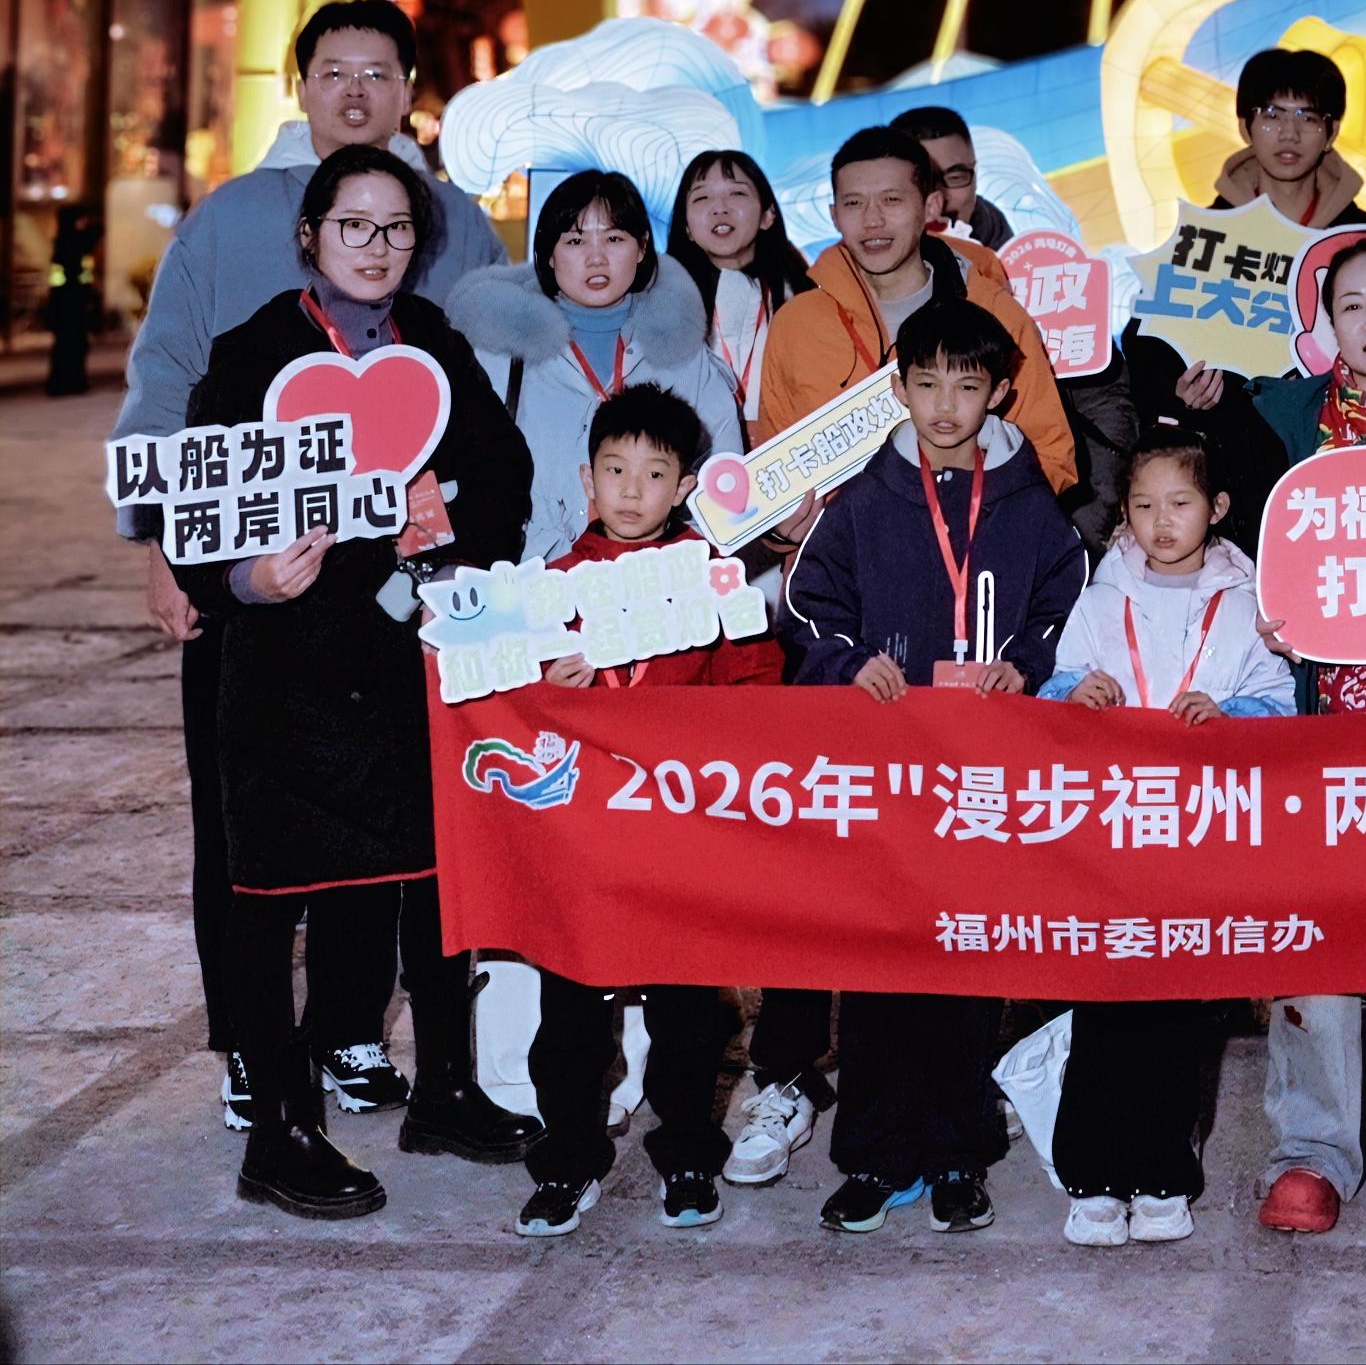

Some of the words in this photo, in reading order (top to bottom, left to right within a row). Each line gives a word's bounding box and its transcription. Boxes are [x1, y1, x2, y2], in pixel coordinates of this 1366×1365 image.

[1172, 224, 1294, 286] 打卡灯
[1134, 263, 1296, 335] 上大分
[116, 420, 346, 501] 以船为证
[756, 387, 903, 501] 打卡船政灯
[174, 477, 397, 559] 两岸同心
[934, 910, 1325, 960] 福州市委网信办
